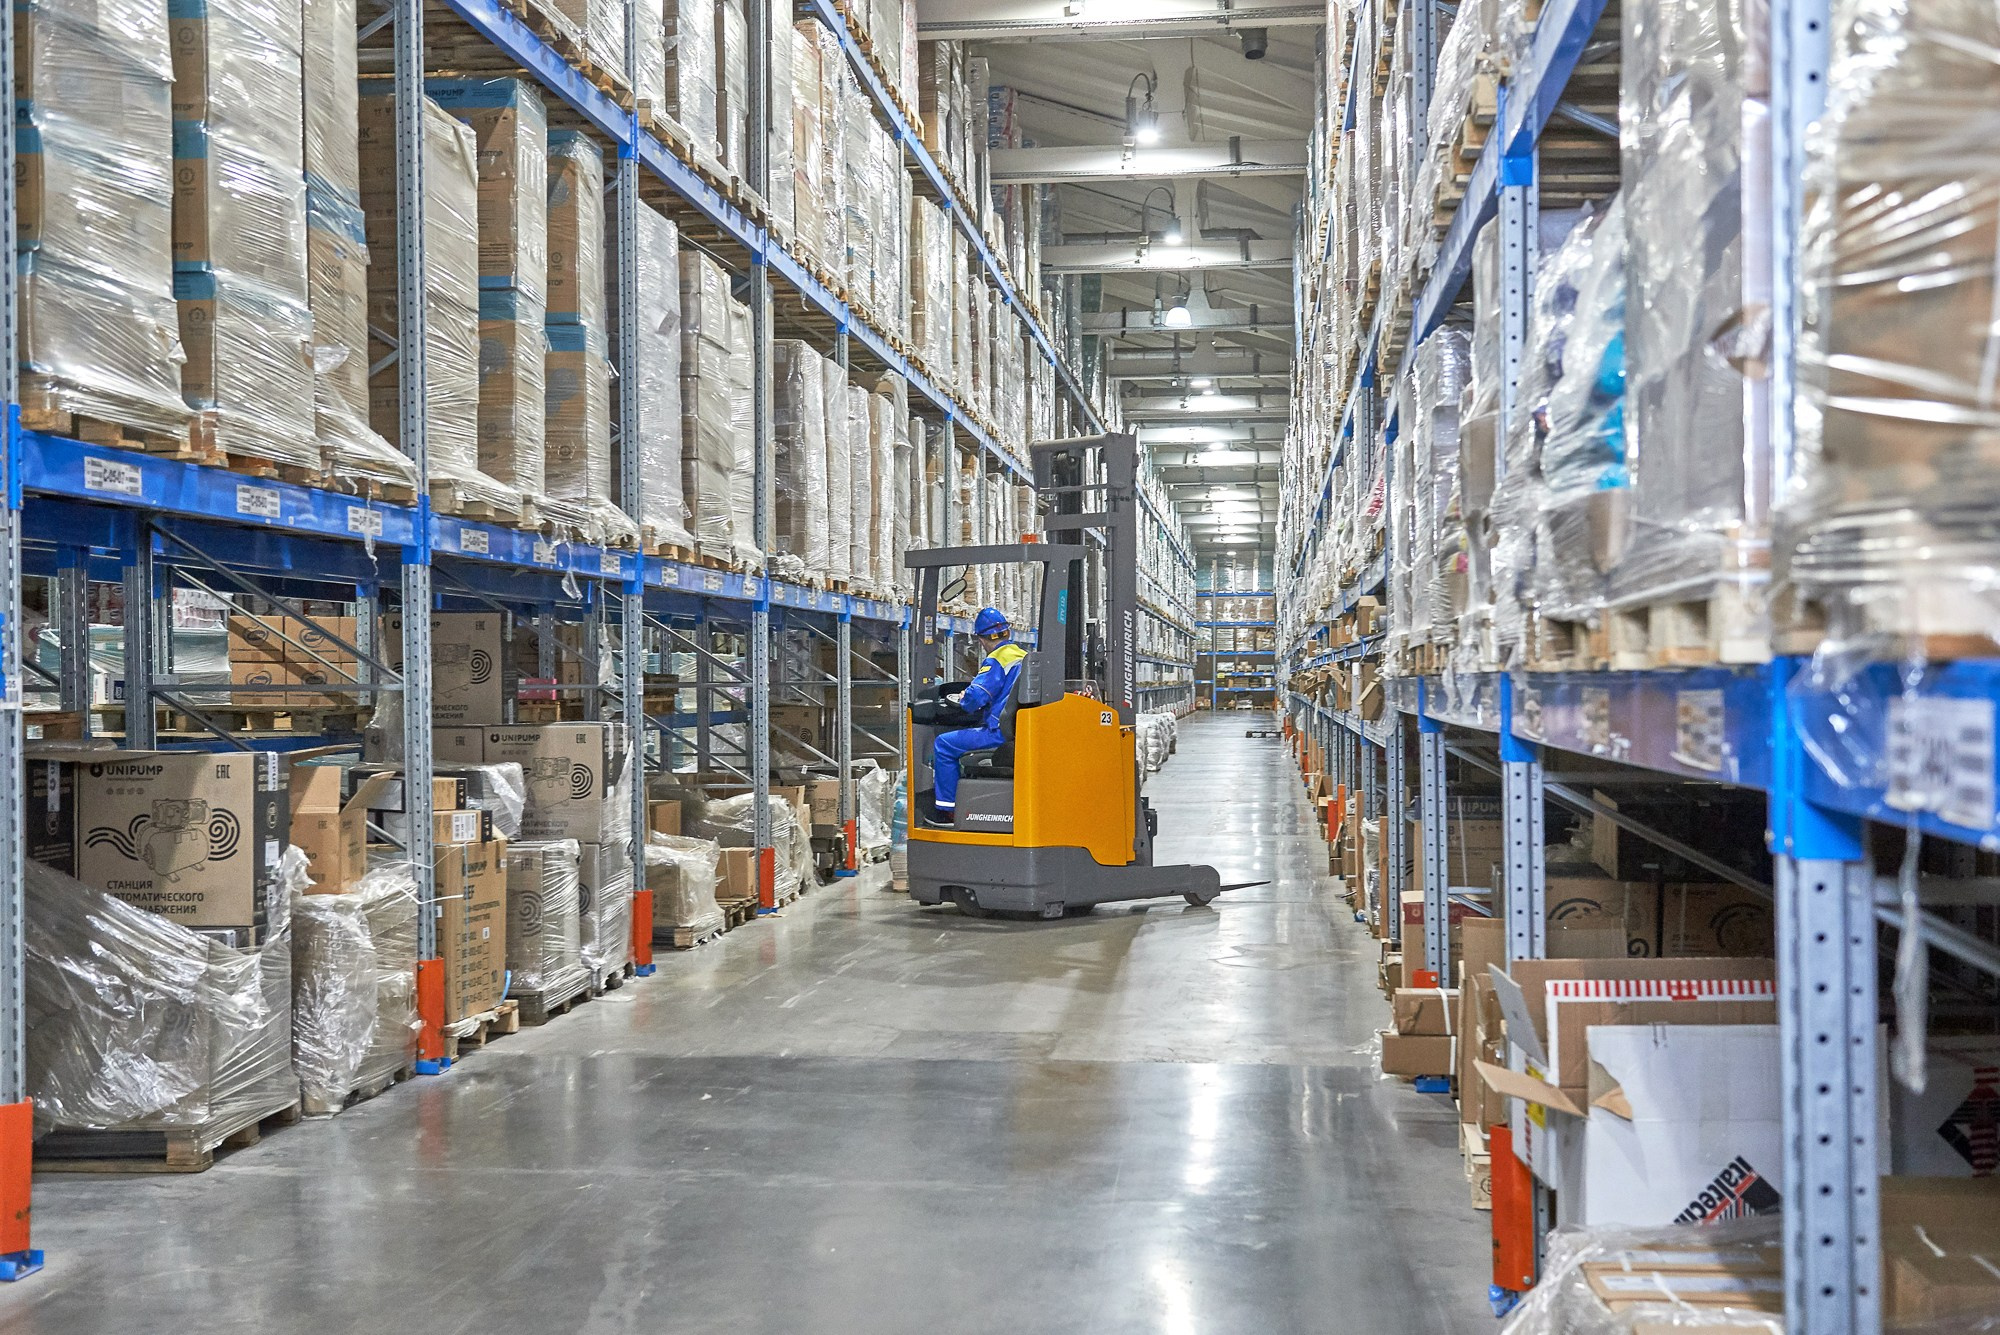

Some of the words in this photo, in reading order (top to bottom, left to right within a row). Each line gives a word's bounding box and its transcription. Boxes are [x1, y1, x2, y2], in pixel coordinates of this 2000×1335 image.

[1124, 611, 1133, 708] JUNGHEINRICH
[1101, 713, 1112, 724] 23
[501, 734, 541, 742] UNIPUMP
[106, 765, 164, 776] UNIPUMP
[966, 813, 1014, 823] JUNGHEINRICH
[106, 880, 153, 890] СТАНЦИЯ
[112, 892, 205, 902] ВТОМАТИЧЕСКОГО
